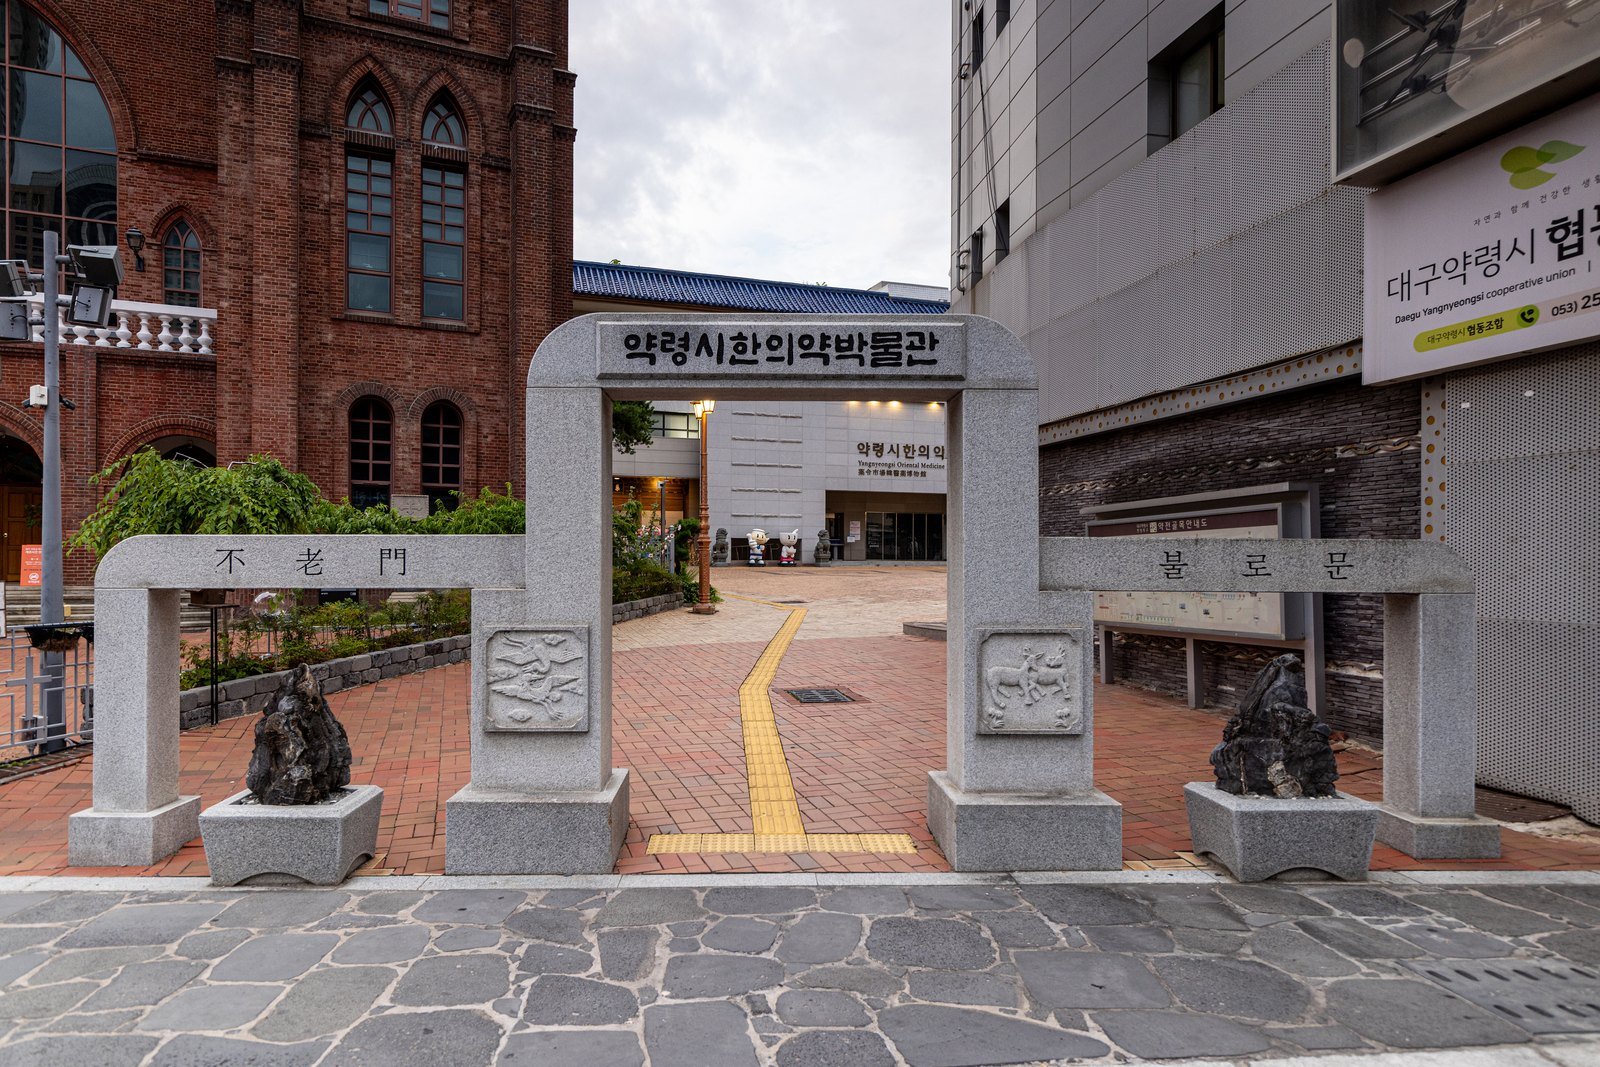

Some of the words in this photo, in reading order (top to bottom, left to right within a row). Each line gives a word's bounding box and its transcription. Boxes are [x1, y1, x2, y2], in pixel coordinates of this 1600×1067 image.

[1387, 228, 1535, 302] 대구약령시
[1395, 309, 1421, 324] Daegu
[1422, 292, 1485, 317] Yangnyeongsi
[1486, 276, 1544, 301] cooperative
[1545, 267, 1576, 283] union
[1551, 301, 1578, 317] 053)
[1427, 328, 1466, 344] 대구약령시
[1467, 317, 1504, 337] 협동조합
[624, 331, 939, 367] 약령시한의약박물관
[215, 548, 407, 577] 不老門
